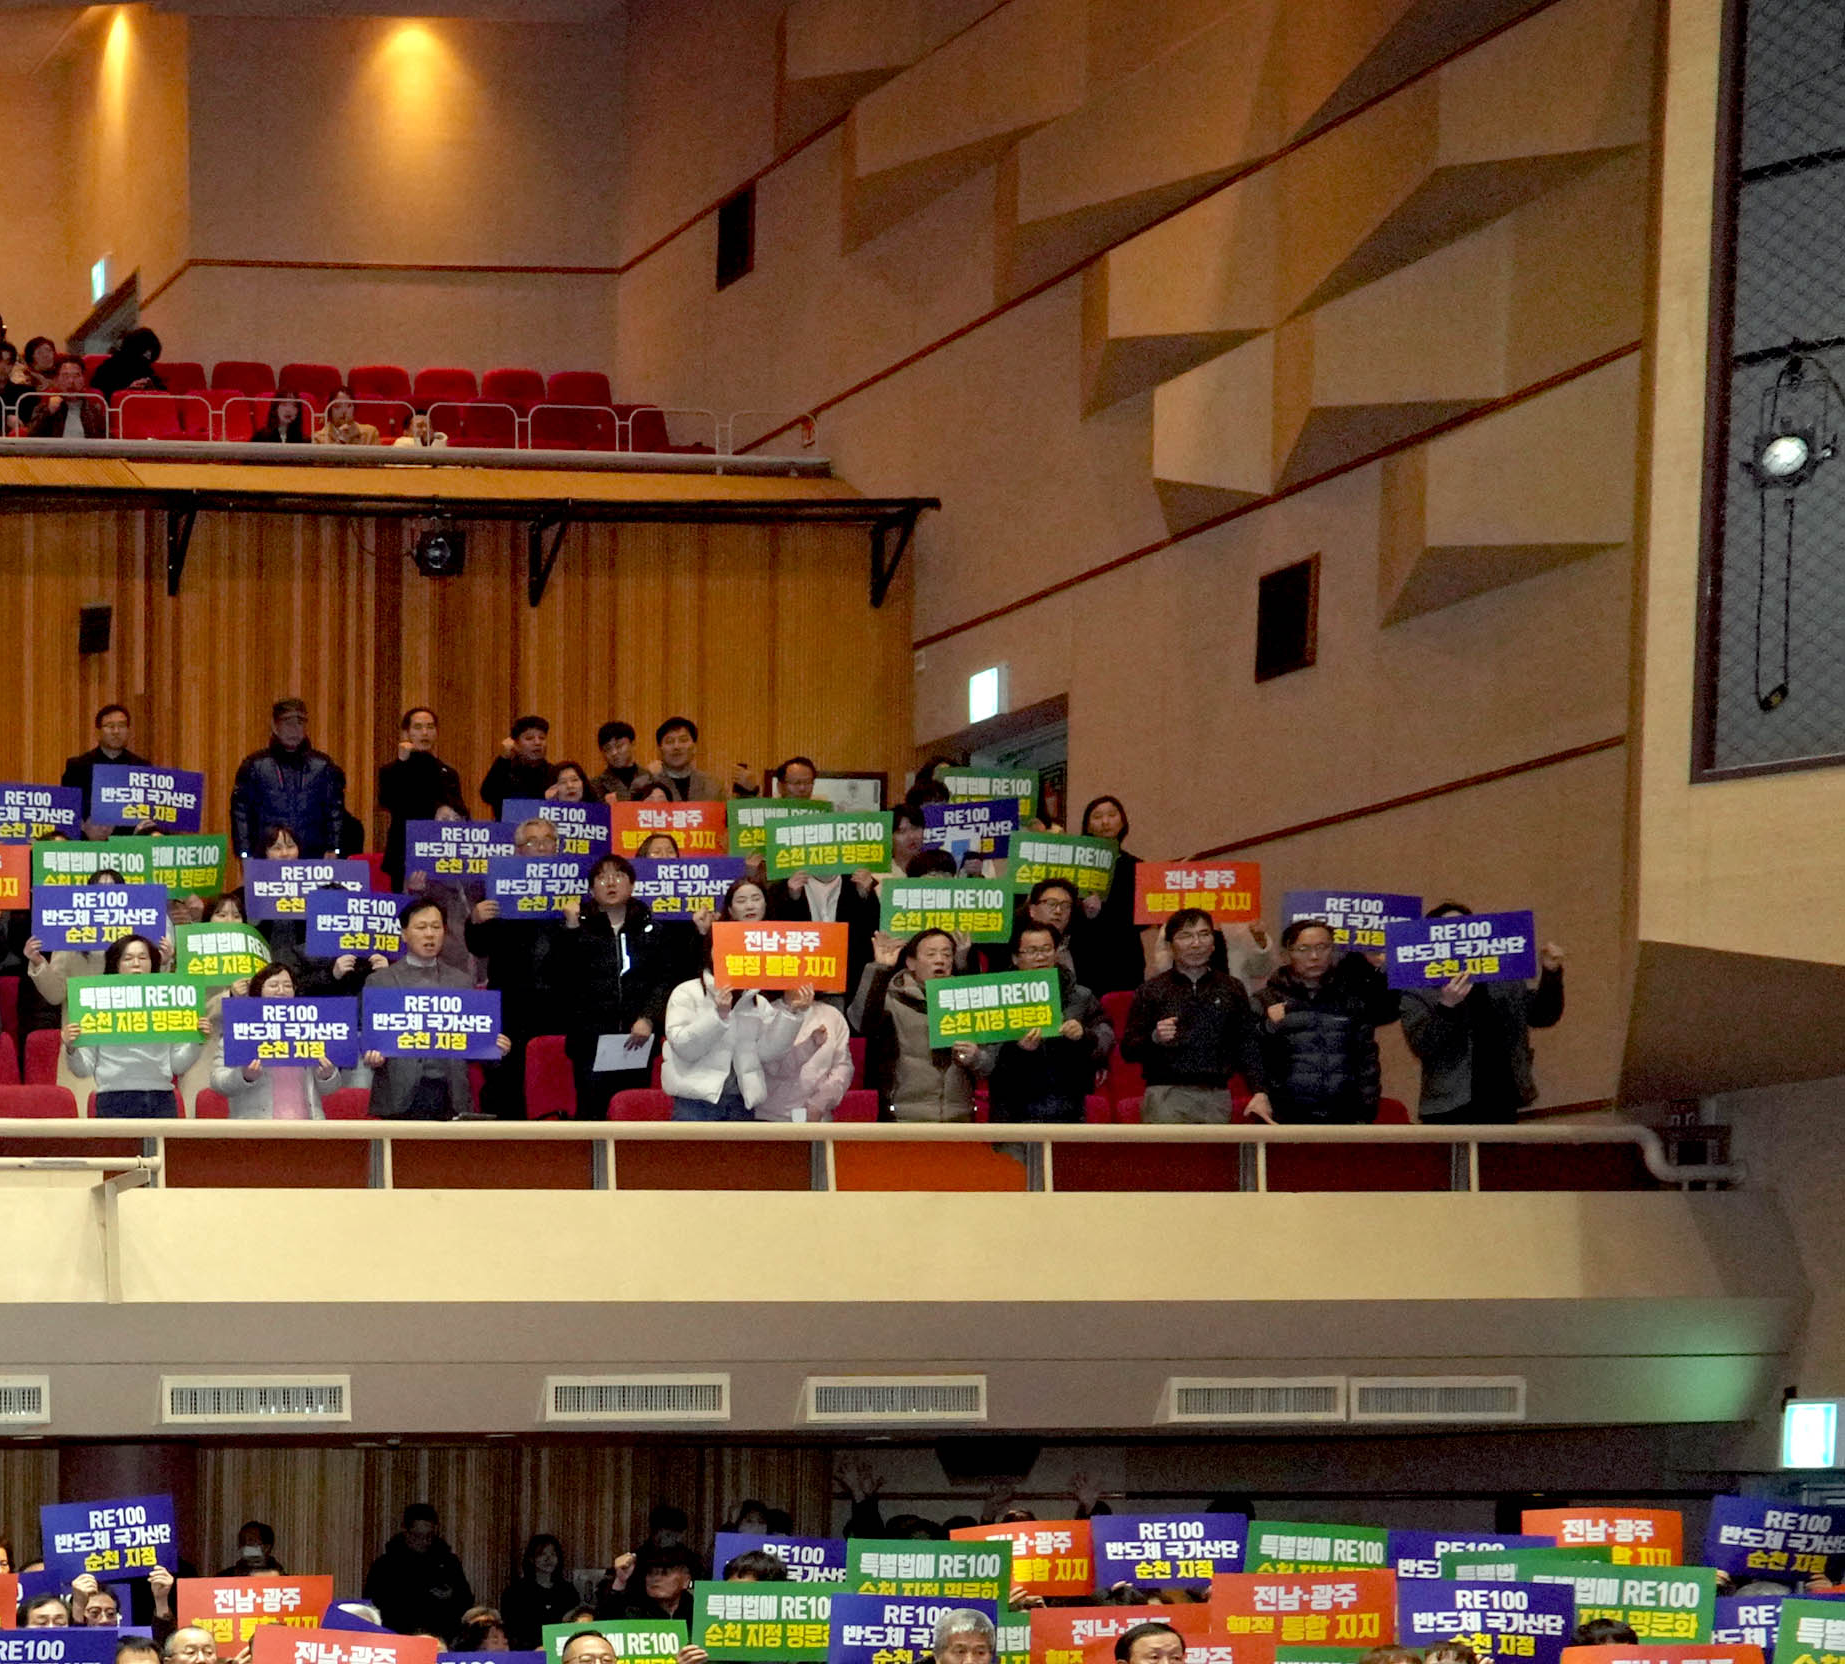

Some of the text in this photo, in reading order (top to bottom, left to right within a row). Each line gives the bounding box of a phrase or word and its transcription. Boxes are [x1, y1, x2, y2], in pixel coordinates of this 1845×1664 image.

[1430, 922, 1491, 940] RE100
[744, 931, 819, 952] 전남·광주
[1397, 939, 1525, 963] 반도체 국가산단
[805, 957, 835, 976] 지지
[1425, 960, 1462, 979] 순천
